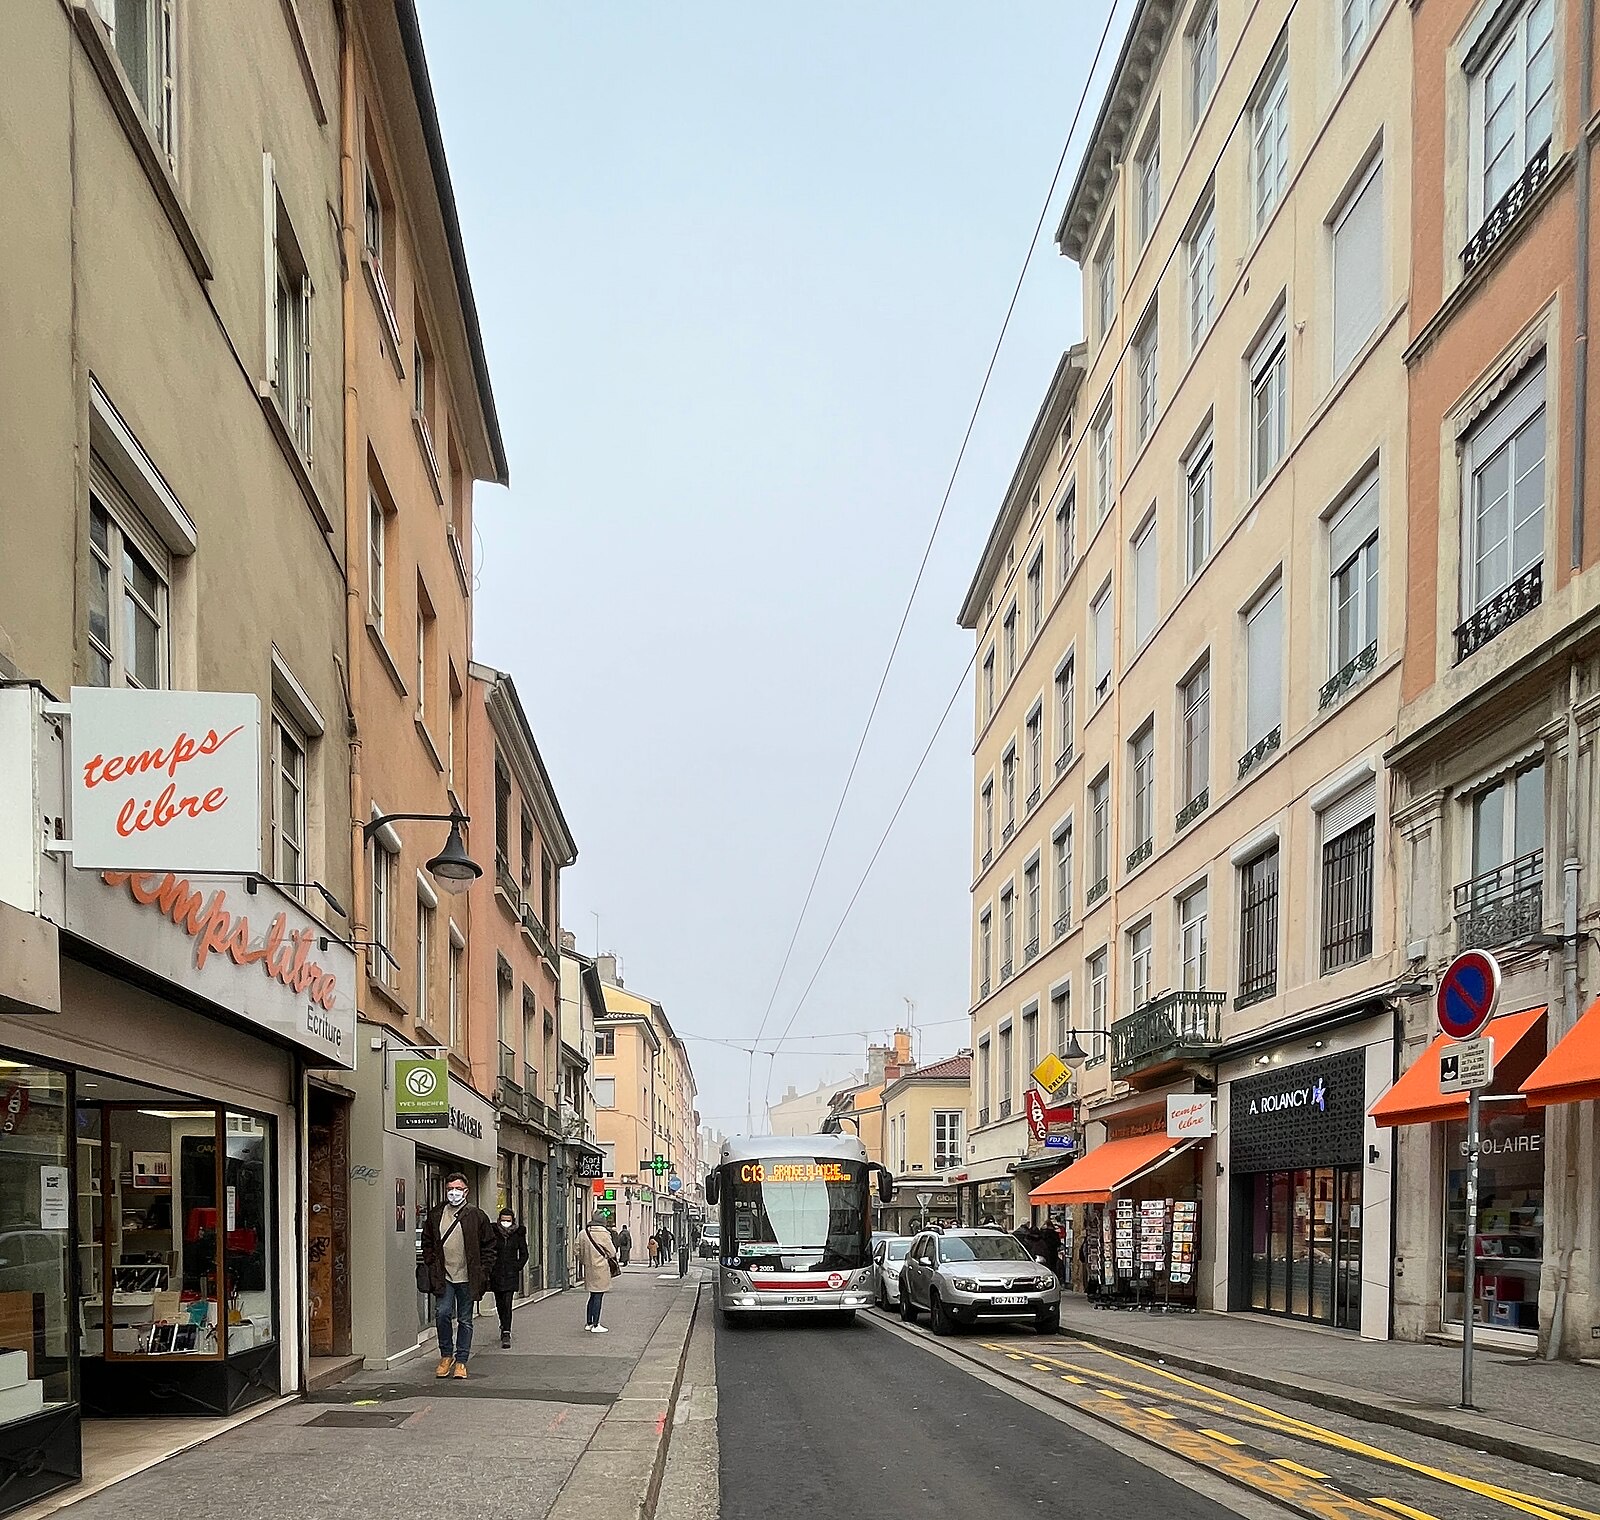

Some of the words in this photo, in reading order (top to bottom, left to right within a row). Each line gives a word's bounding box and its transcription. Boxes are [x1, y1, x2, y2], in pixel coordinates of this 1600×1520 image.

[82, 724, 246, 789] temps
[114, 781, 229, 838] libre
[262, 911, 338, 1011] libre
[1047, 1070, 1070, 1092] PRESSE
[1171, 1101, 1209, 1119] temps
[1249, 1099, 1259, 1115] A.
[1260, 1088, 1310, 1113] ROLANCY
[1028, 1091, 1046, 1138] TABAC
[1177, 1116, 1205, 1131] libre
[582, 1155, 601, 1164] Karl
[741, 1164, 766, 1182] C13
[773, 1163, 805, 1175] GRANGE
[806, 1163, 842, 1175] BLANCHE
